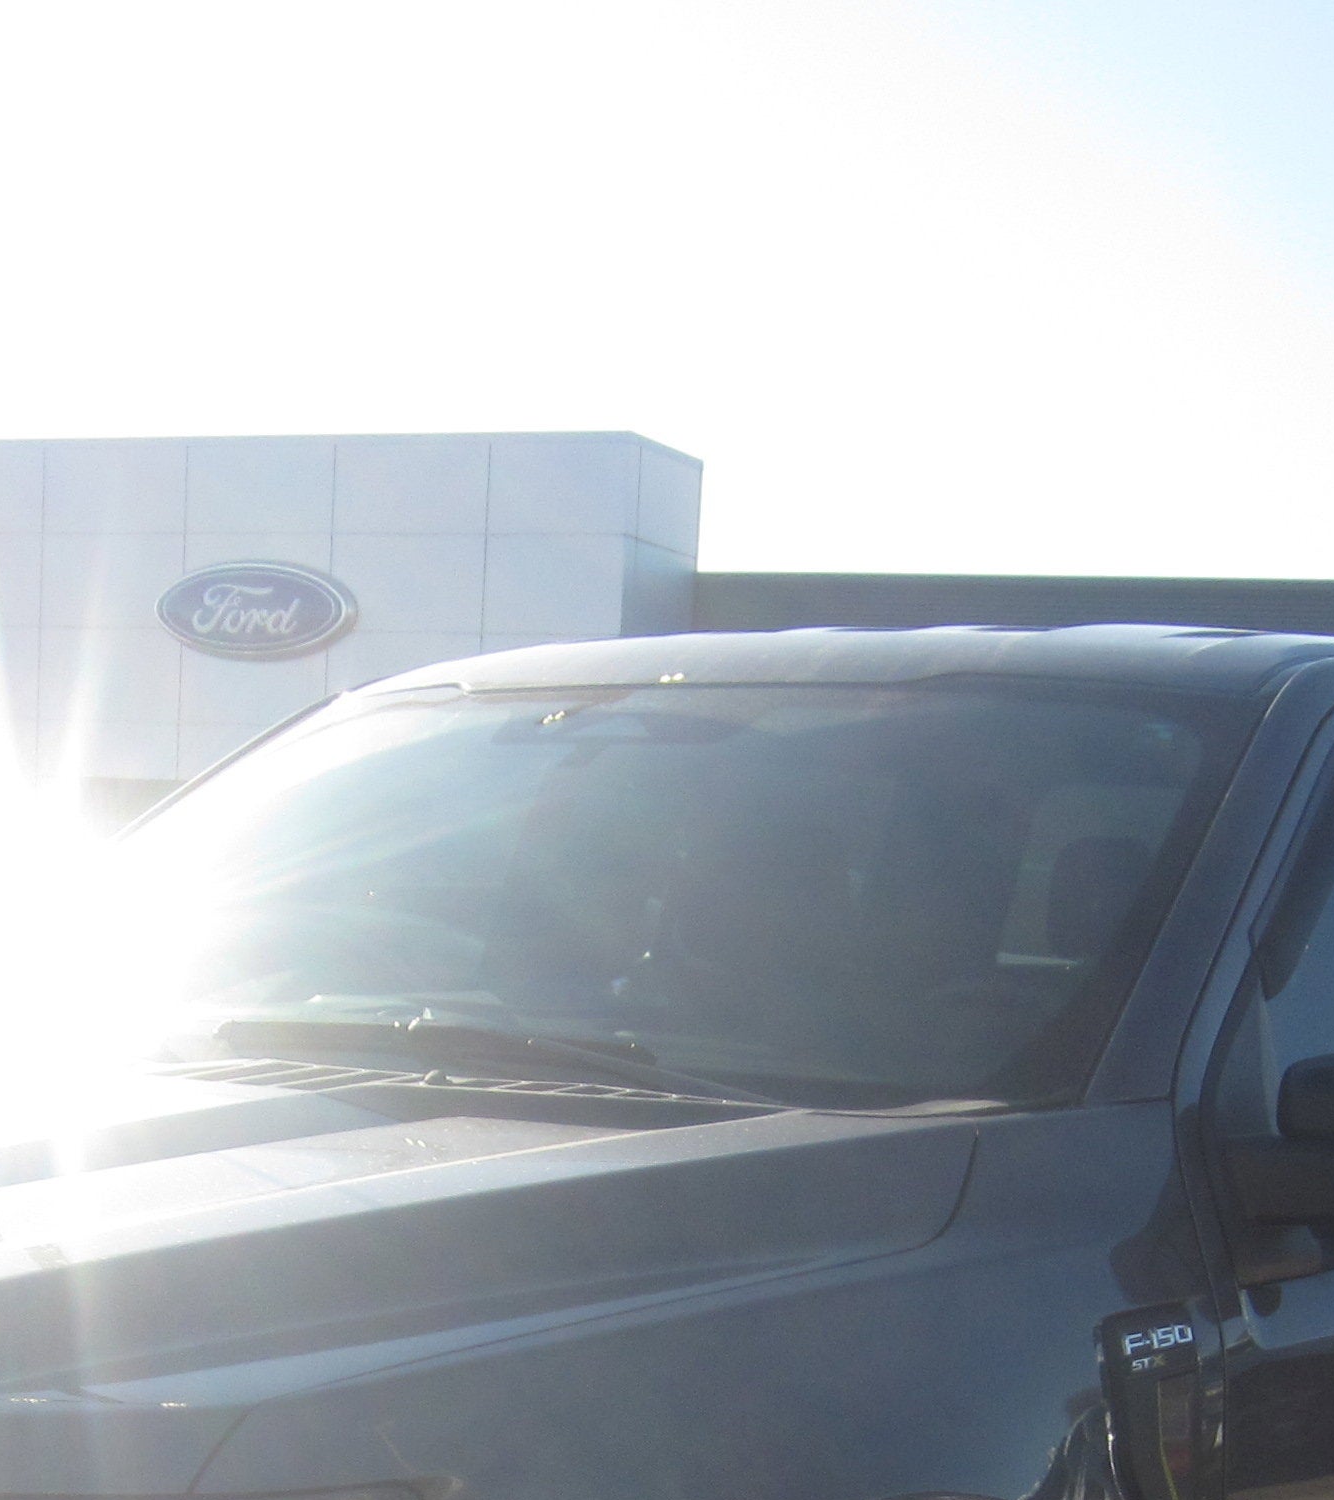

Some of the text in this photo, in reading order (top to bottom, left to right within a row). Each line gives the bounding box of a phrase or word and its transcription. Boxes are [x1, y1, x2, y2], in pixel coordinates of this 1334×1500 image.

[192, 583, 300, 634] Ford
[1124, 1325, 1193, 1355] F-150
[1132, 1354, 1165, 1371] STX
